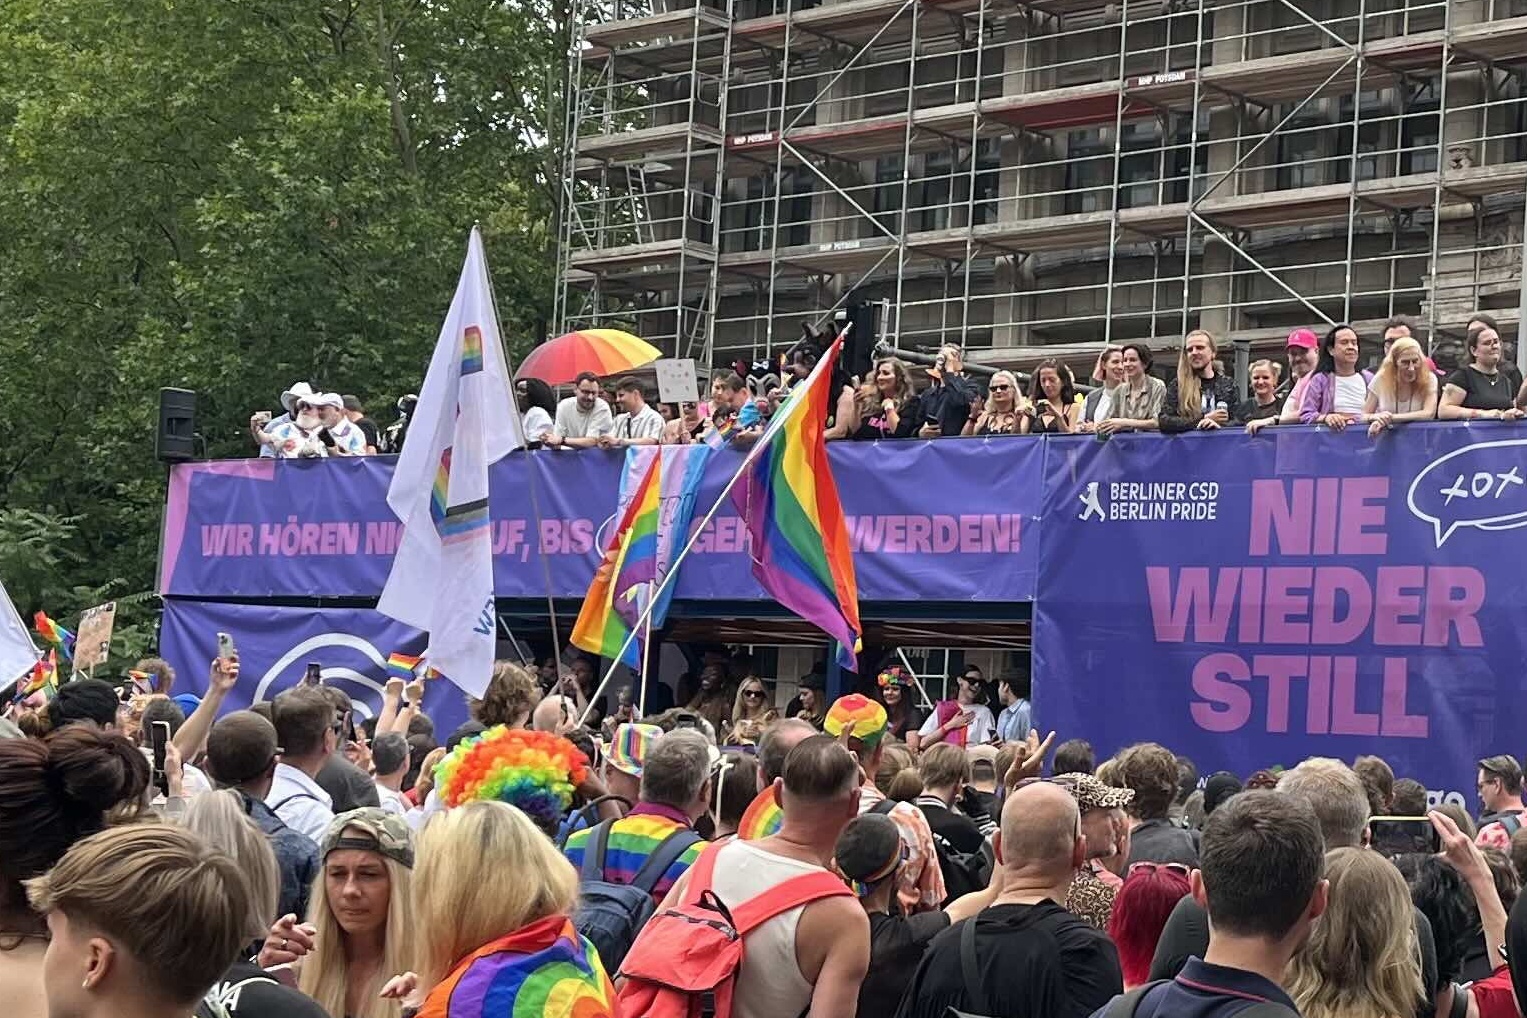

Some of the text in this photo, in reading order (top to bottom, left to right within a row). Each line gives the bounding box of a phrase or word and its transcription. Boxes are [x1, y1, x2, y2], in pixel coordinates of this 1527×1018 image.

[1110, 482, 1219, 501] BERLINER CSD
[1110, 502, 1217, 520] BERLIN PRIDE
[1249, 476, 1389, 556] NIE
[201, 523, 254, 556] WIR
[258, 515, 360, 556] HÖREN
[490, 519, 530, 562] UF,
[538, 519, 594, 554] BIS
[845, 514, 1021, 553] WERDEN!
[1145, 566, 1486, 648] WIEDER
[1190, 653, 1428, 738] STILL
